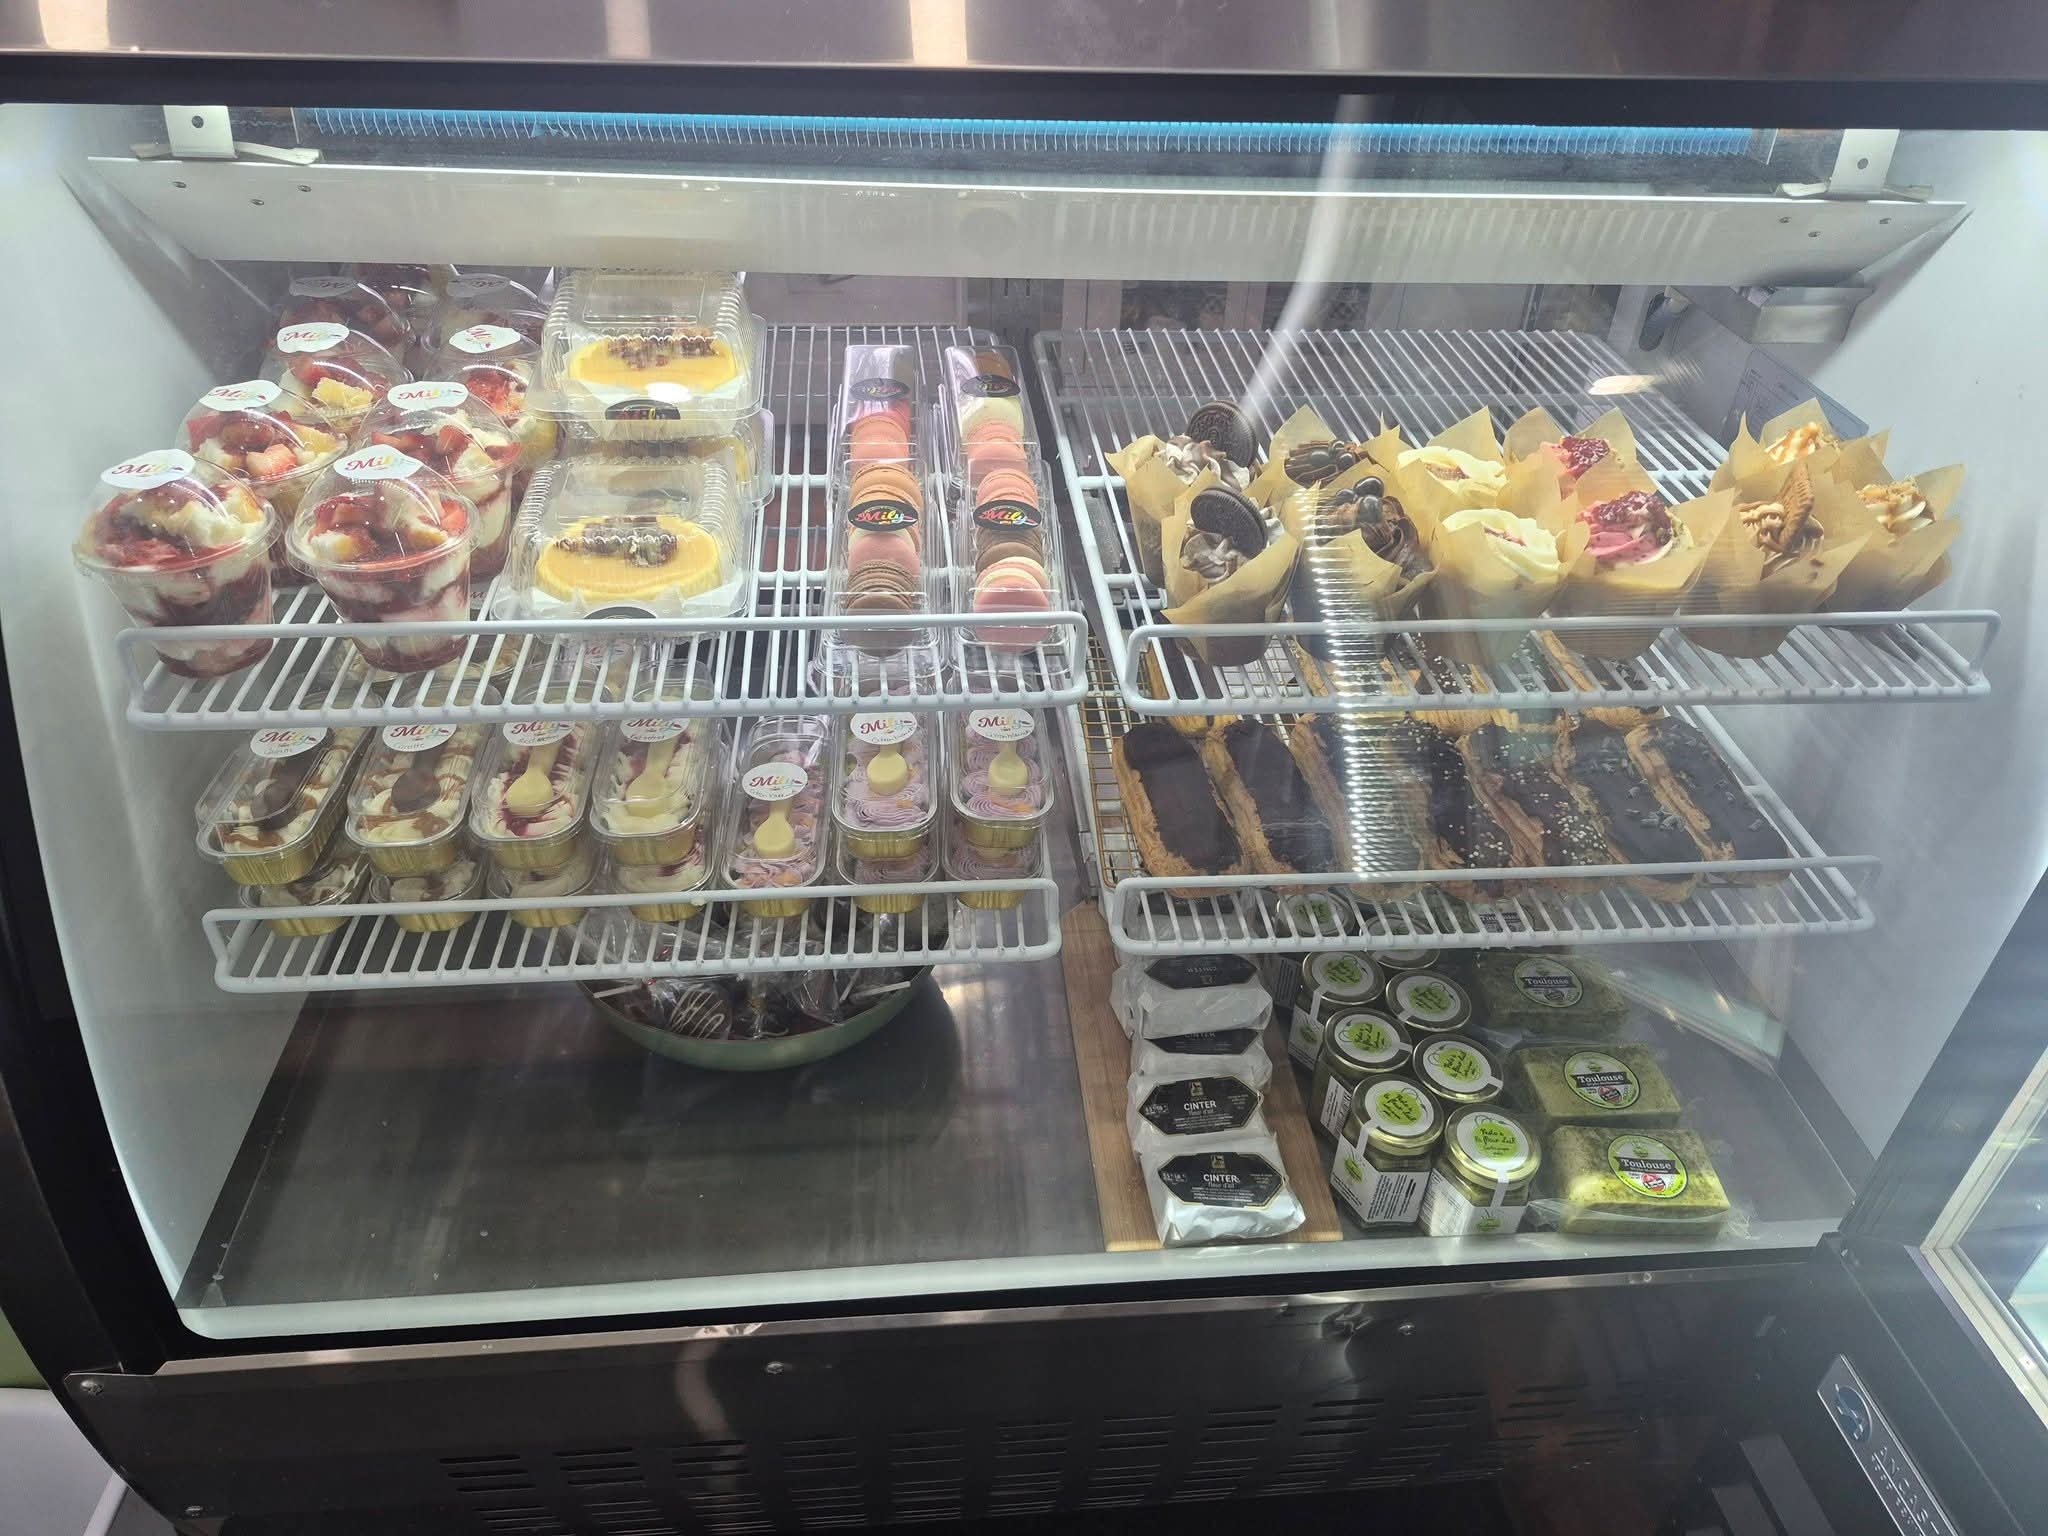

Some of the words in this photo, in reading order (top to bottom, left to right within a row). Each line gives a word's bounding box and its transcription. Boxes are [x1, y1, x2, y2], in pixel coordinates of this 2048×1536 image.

[856, 507, 917, 525] Mily
[978, 506, 1039, 527] Mily
[390, 720, 448, 738] Mily
[860, 718, 913, 735] Mily
[977, 714, 1033, 729] Mily
[260, 730, 317, 746] Mily
[749, 775, 804, 790] Mily
[1525, 978, 1570, 986] Toulouse
[1577, 1073, 1624, 1083] Toulouse
[1183, 1100, 1217, 1111] CINTER
[1621, 1159, 1672, 1170] Toulouse
[1203, 1173, 1238, 1183] CINTER
